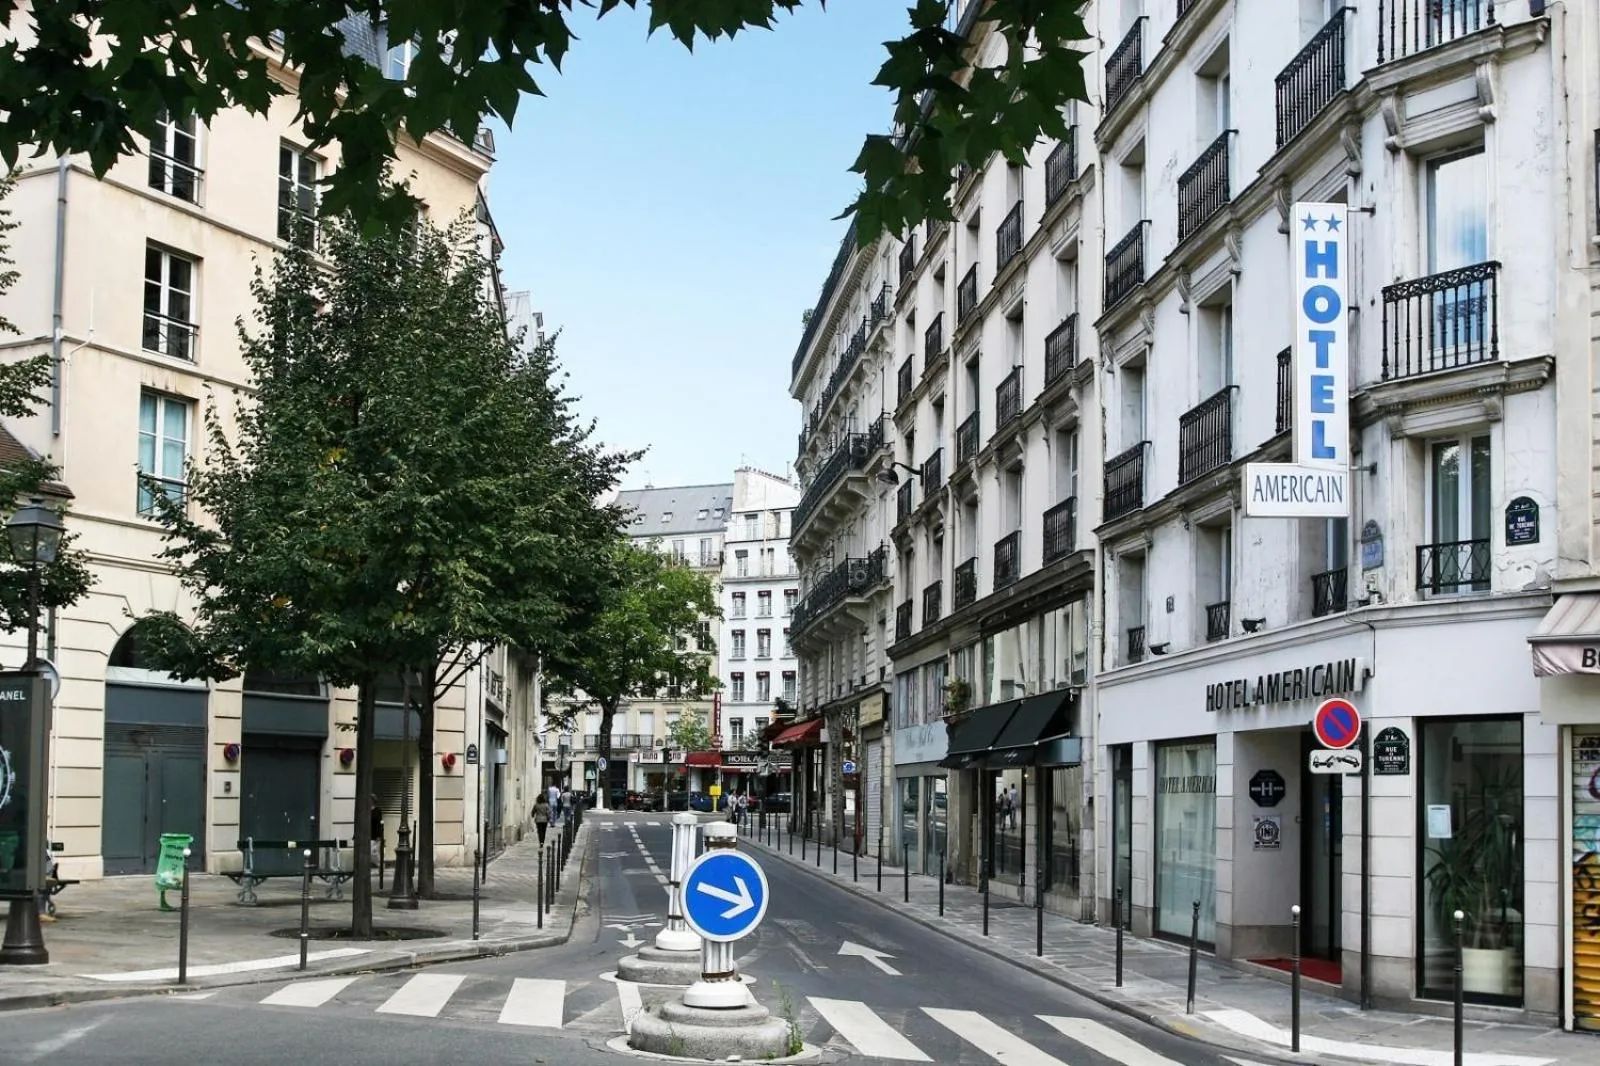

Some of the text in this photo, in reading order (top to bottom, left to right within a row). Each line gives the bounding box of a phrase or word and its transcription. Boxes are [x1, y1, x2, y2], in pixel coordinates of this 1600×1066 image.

[1302, 239, 1341, 459] HOTEL
[1252, 474, 1343, 503] AMERICAIN
[1581, 647, 1600, 668] B
[1206, 658, 1355, 712] HOTEL AMERICAIN
